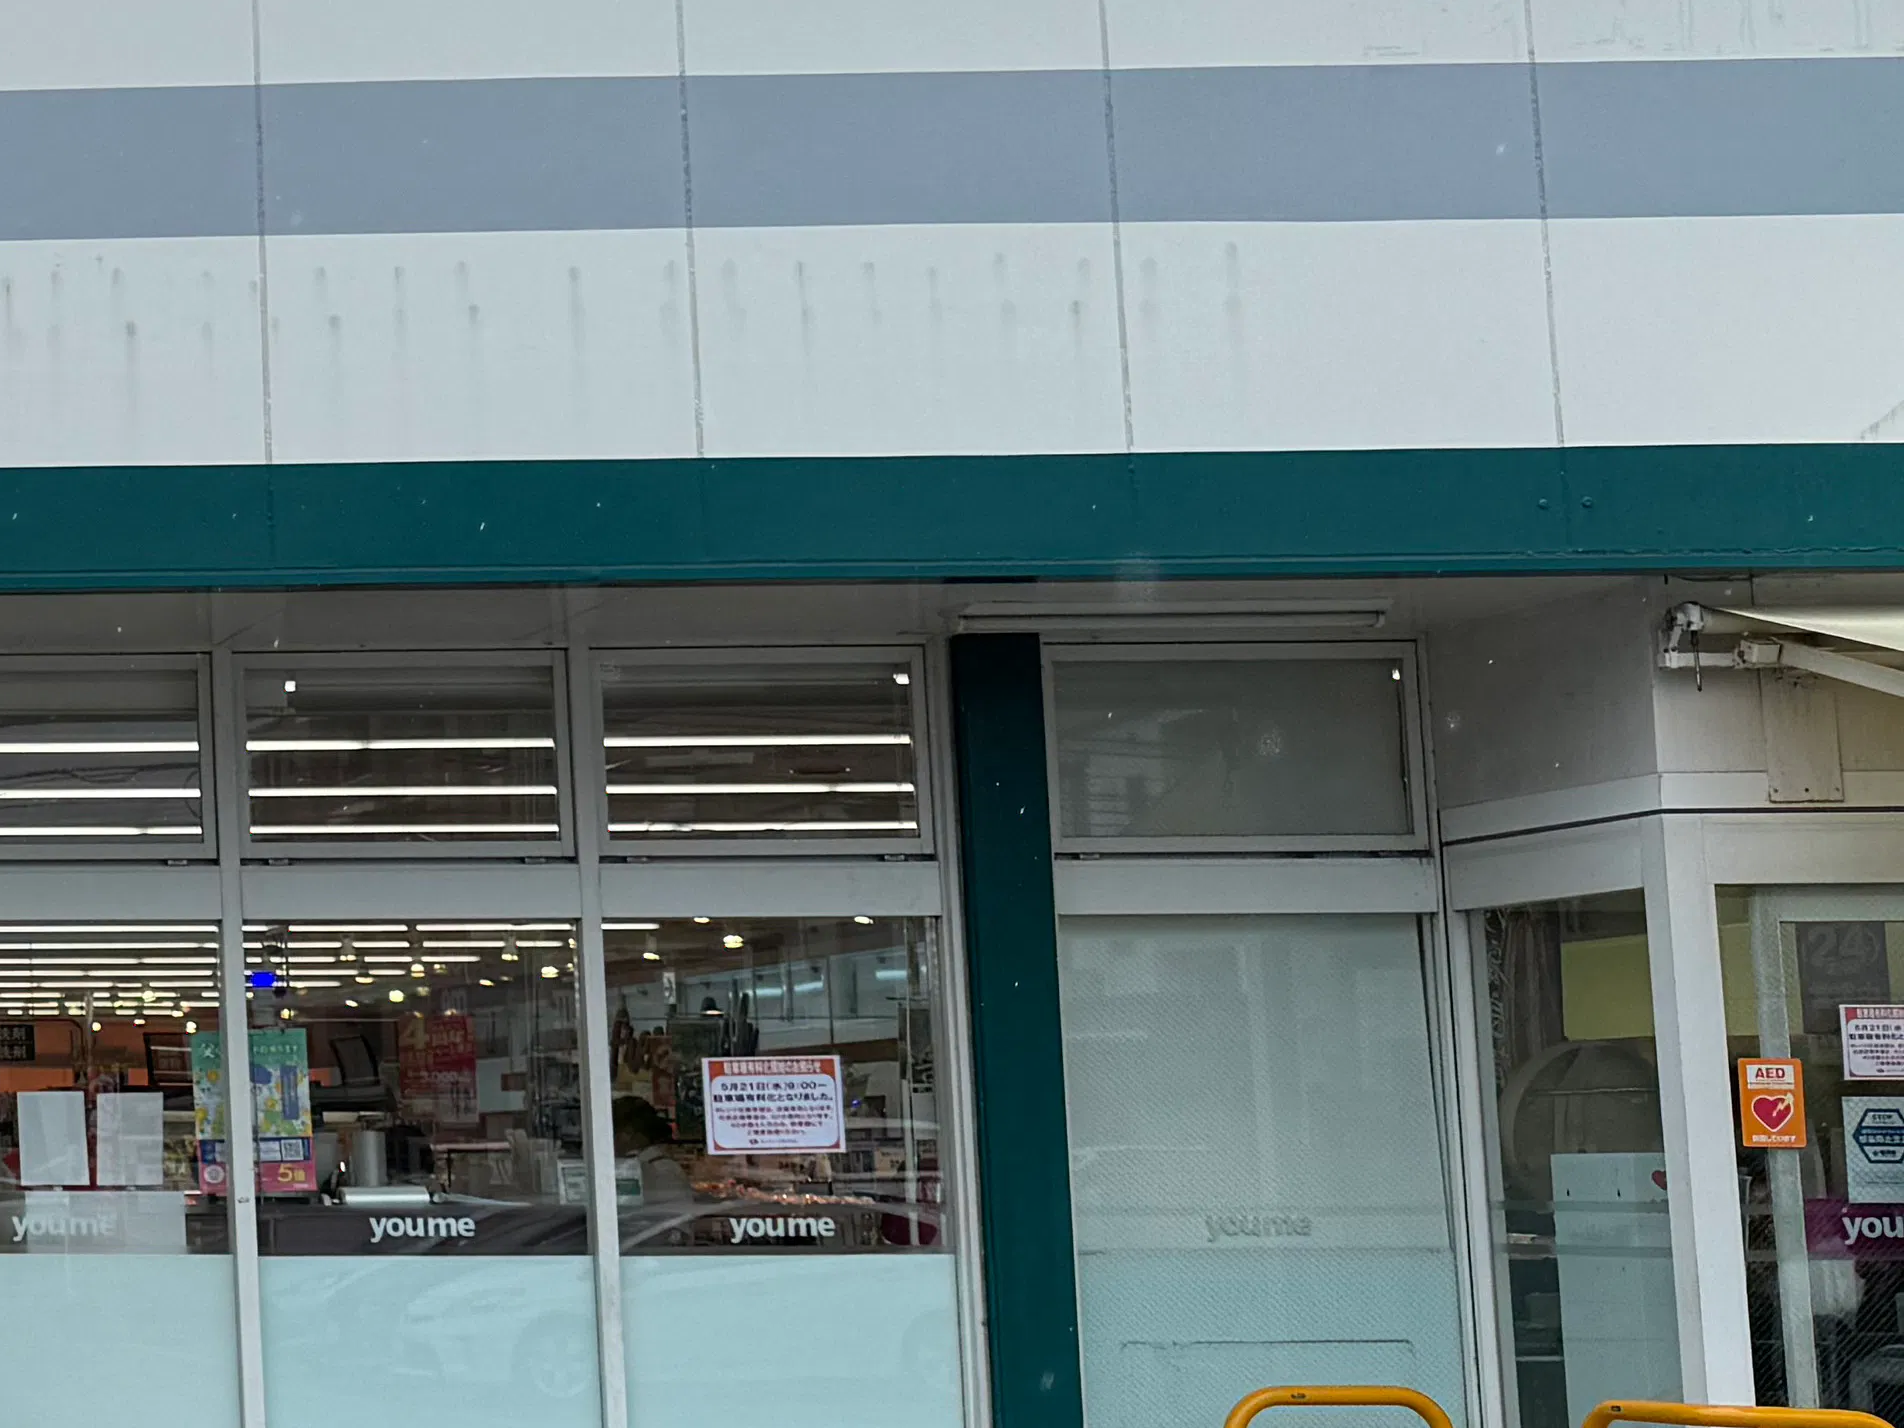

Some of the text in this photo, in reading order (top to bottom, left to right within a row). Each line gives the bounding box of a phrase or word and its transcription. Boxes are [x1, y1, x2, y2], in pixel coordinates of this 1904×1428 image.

[1755, 1067, 1786, 1079] AED
[11, 1212, 118, 1242] youme
[368, 1215, 476, 1243] youme
[729, 1215, 835, 1244] youme
